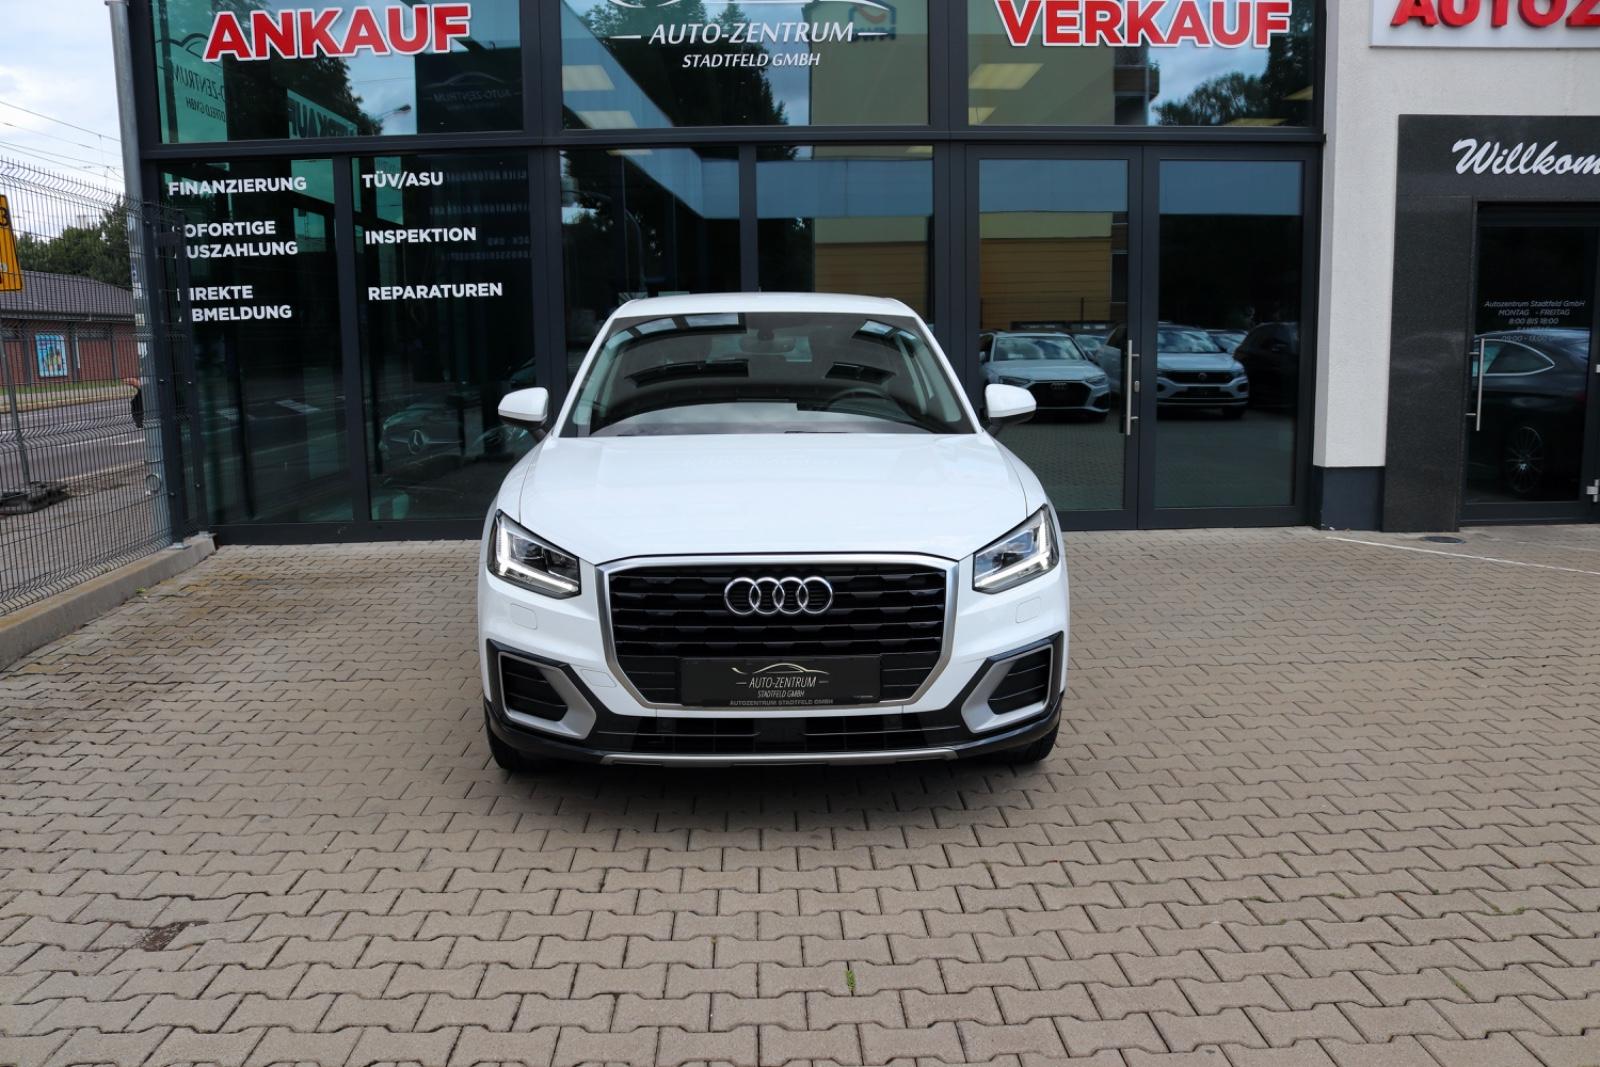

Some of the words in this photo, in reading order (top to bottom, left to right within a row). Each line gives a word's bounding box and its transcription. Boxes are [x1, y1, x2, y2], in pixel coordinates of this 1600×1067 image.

[203, 2, 471, 62] ANKAUF
[649, 21, 853, 45] AUTO-ZENTRUM
[994, 0, 1292, 48] VERKAUF
[682, 54, 768, 68] STADTFELD
[772, 52, 820, 66] GMBH
[168, 176, 307, 196] FINANZIERUNG
[362, 171, 444, 189] TÜV/ASU
[365, 227, 477, 245] INSPEKTION
[174, 241, 298, 259] USZAHLUNG
[177, 285, 254, 302] IREKTE
[368, 282, 503, 301] REPARATUREN
[179, 305, 293, 323] BMELDUNG
[749, 677, 817, 689] AUTO-ZENTRUM
[758, 690, 786, 698] STADTFELD
[787, 689, 805, 697] GMBH
